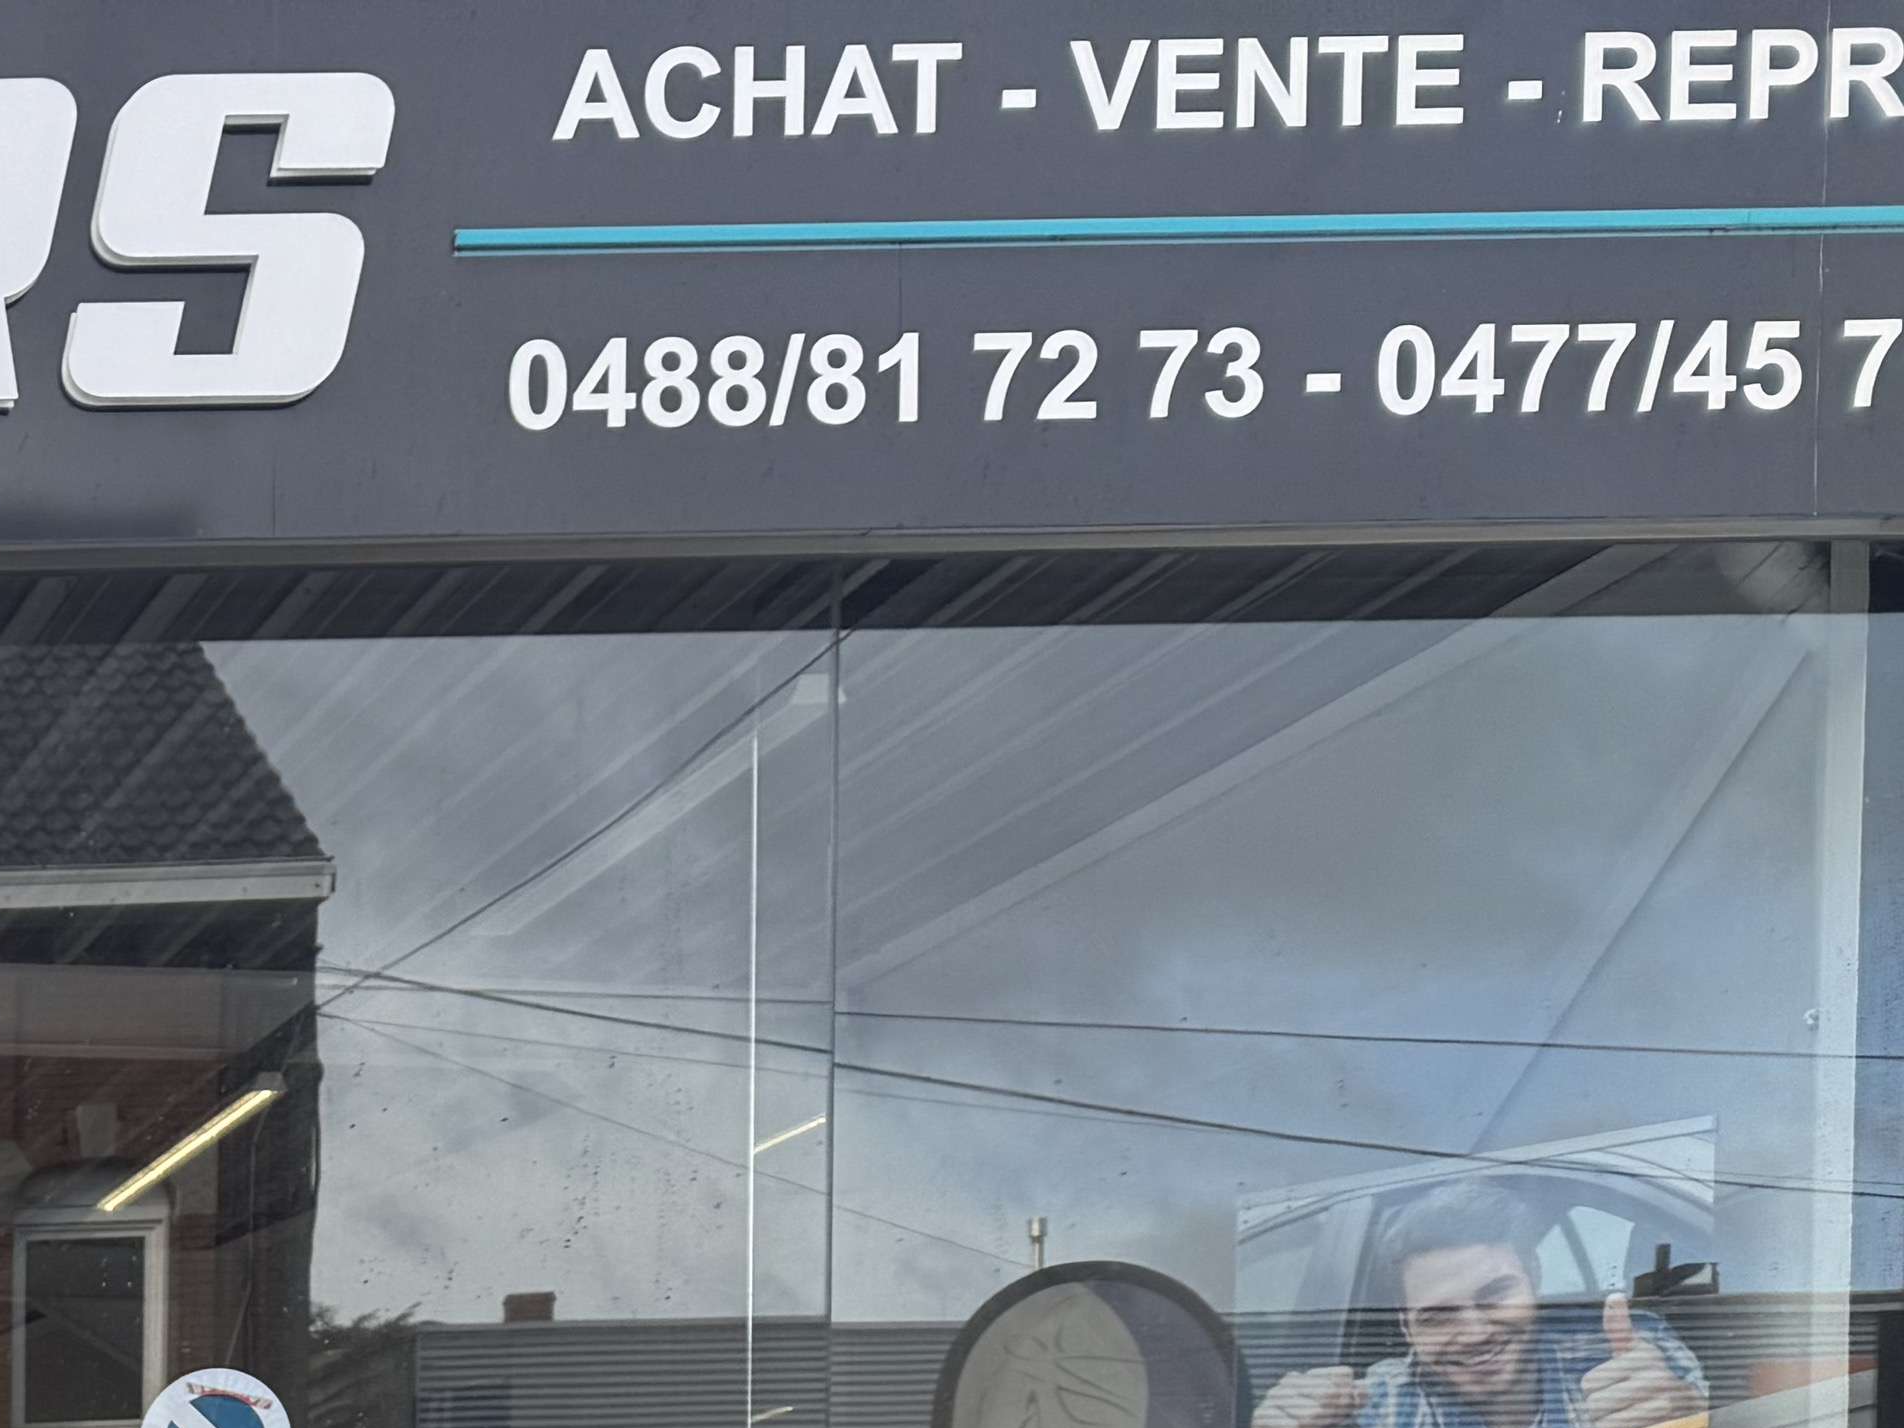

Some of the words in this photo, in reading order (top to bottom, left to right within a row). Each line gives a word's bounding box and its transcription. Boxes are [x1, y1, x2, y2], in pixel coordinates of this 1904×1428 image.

[551, 42, 964, 141] ACHAT
[1069, 32, 1467, 132] VENTE
[507, 331, 922, 431] 0488/81
[971, 328, 1099, 423] 72
[1136, 326, 1266, 421] 73
[1375, 316, 1805, 417] 0477/45
